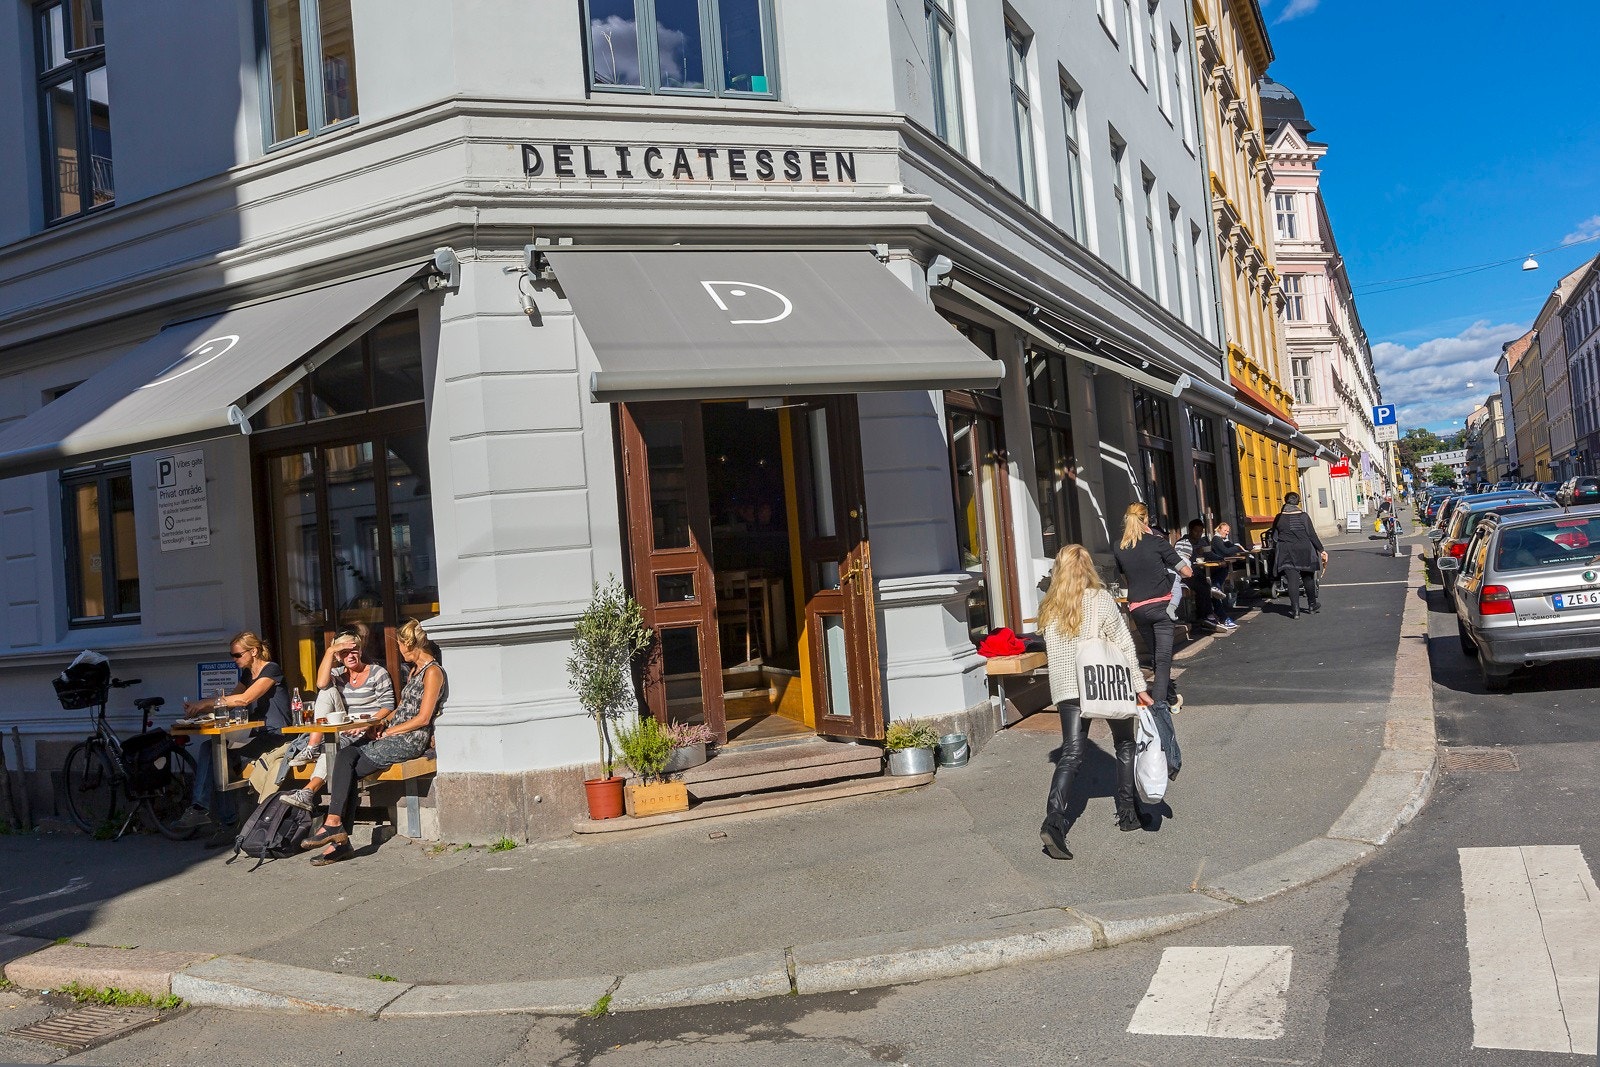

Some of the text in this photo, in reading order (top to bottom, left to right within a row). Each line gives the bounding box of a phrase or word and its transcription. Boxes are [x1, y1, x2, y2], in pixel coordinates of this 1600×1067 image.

[521, 144, 856, 183] DELICATESSEN
[1377, 407, 1391, 424] P
[176, 458, 203, 468] Vibes gate
[159, 460, 172, 485] P
[160, 489, 177, 499] Privat
[1567, 592, 1600, 605] ZE 6
[1083, 664, 1135, 702] BRRR!
[641, 794, 680, 806] NORTE
